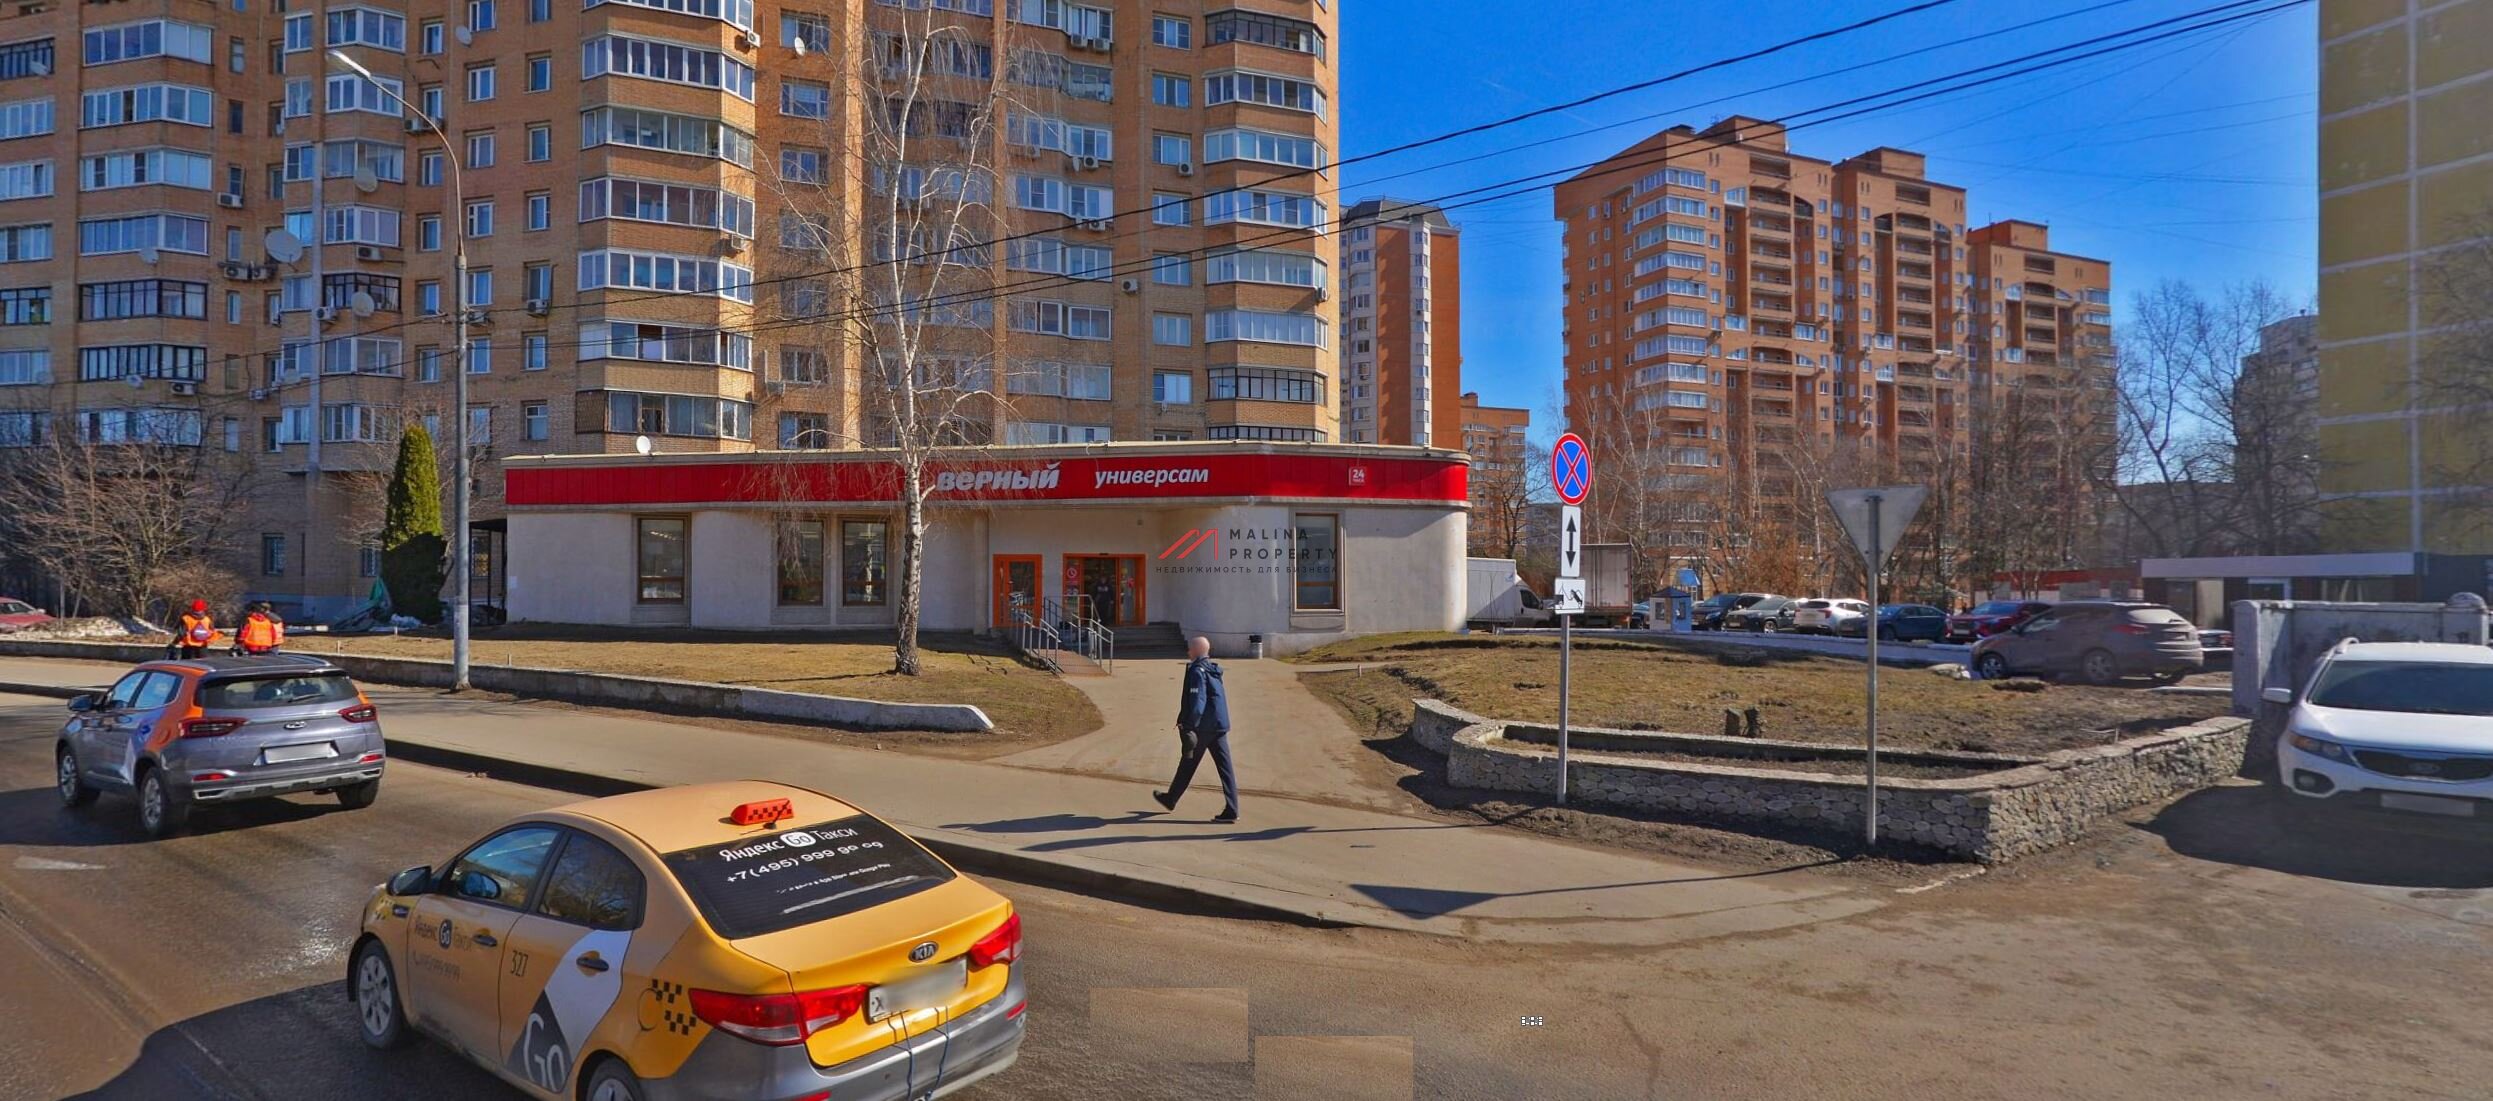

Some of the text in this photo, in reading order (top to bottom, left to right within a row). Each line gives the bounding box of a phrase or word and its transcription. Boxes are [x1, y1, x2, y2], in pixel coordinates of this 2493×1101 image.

[935, 461, 1209, 492] верный универсам
[719, 839, 785, 862] Яндекс
[810, 828, 858, 840] Такси
[801, 849, 835, 862] 999
[511, 950, 528, 977] 327
[914, 945, 936, 961] KIA
[523, 1012, 566, 1093] Go
